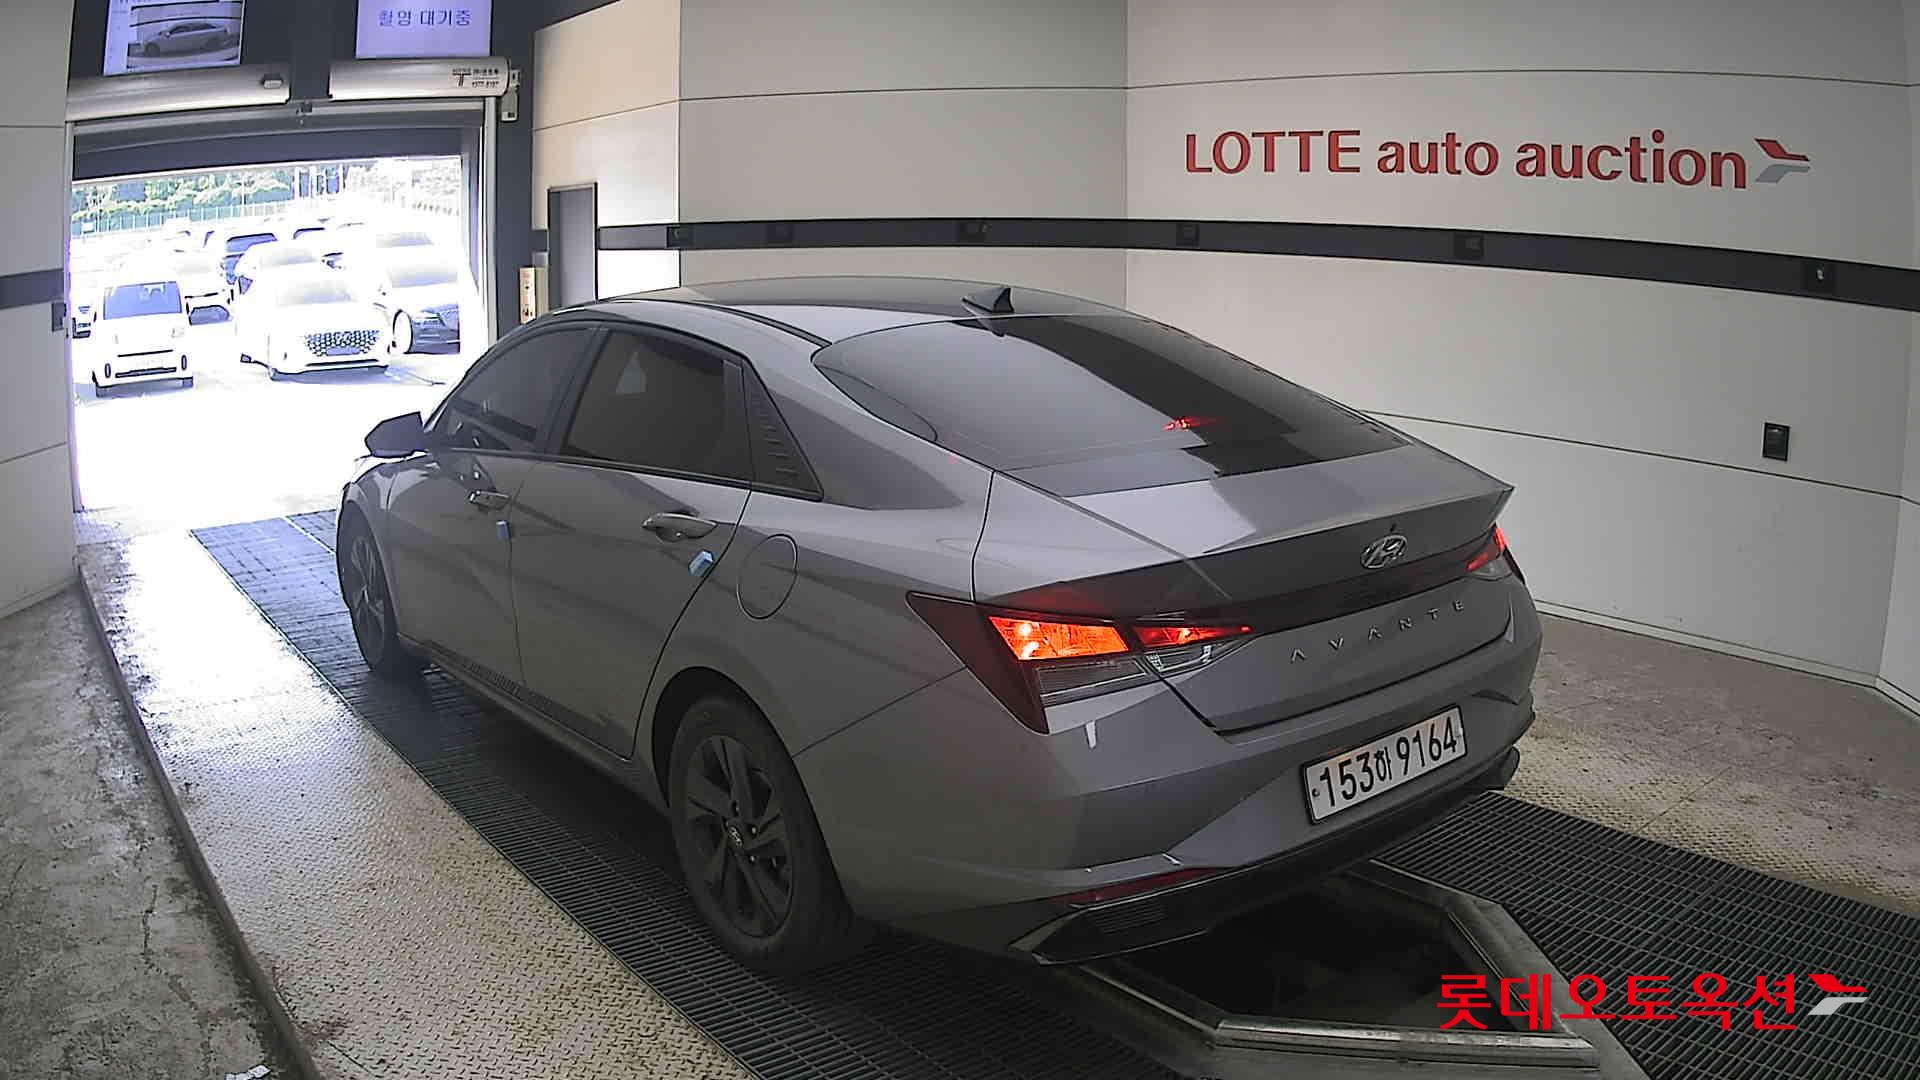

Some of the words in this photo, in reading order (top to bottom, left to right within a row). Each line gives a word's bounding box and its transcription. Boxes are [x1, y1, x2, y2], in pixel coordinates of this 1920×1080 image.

[420, 9, 472, 27] 대기중
[1186, 130, 1362, 173] LOTTE
[1377, 132, 1499, 176] auto
[1515, 129, 1748, 188] auction
[1290, 600, 1465, 662] AVANTE
